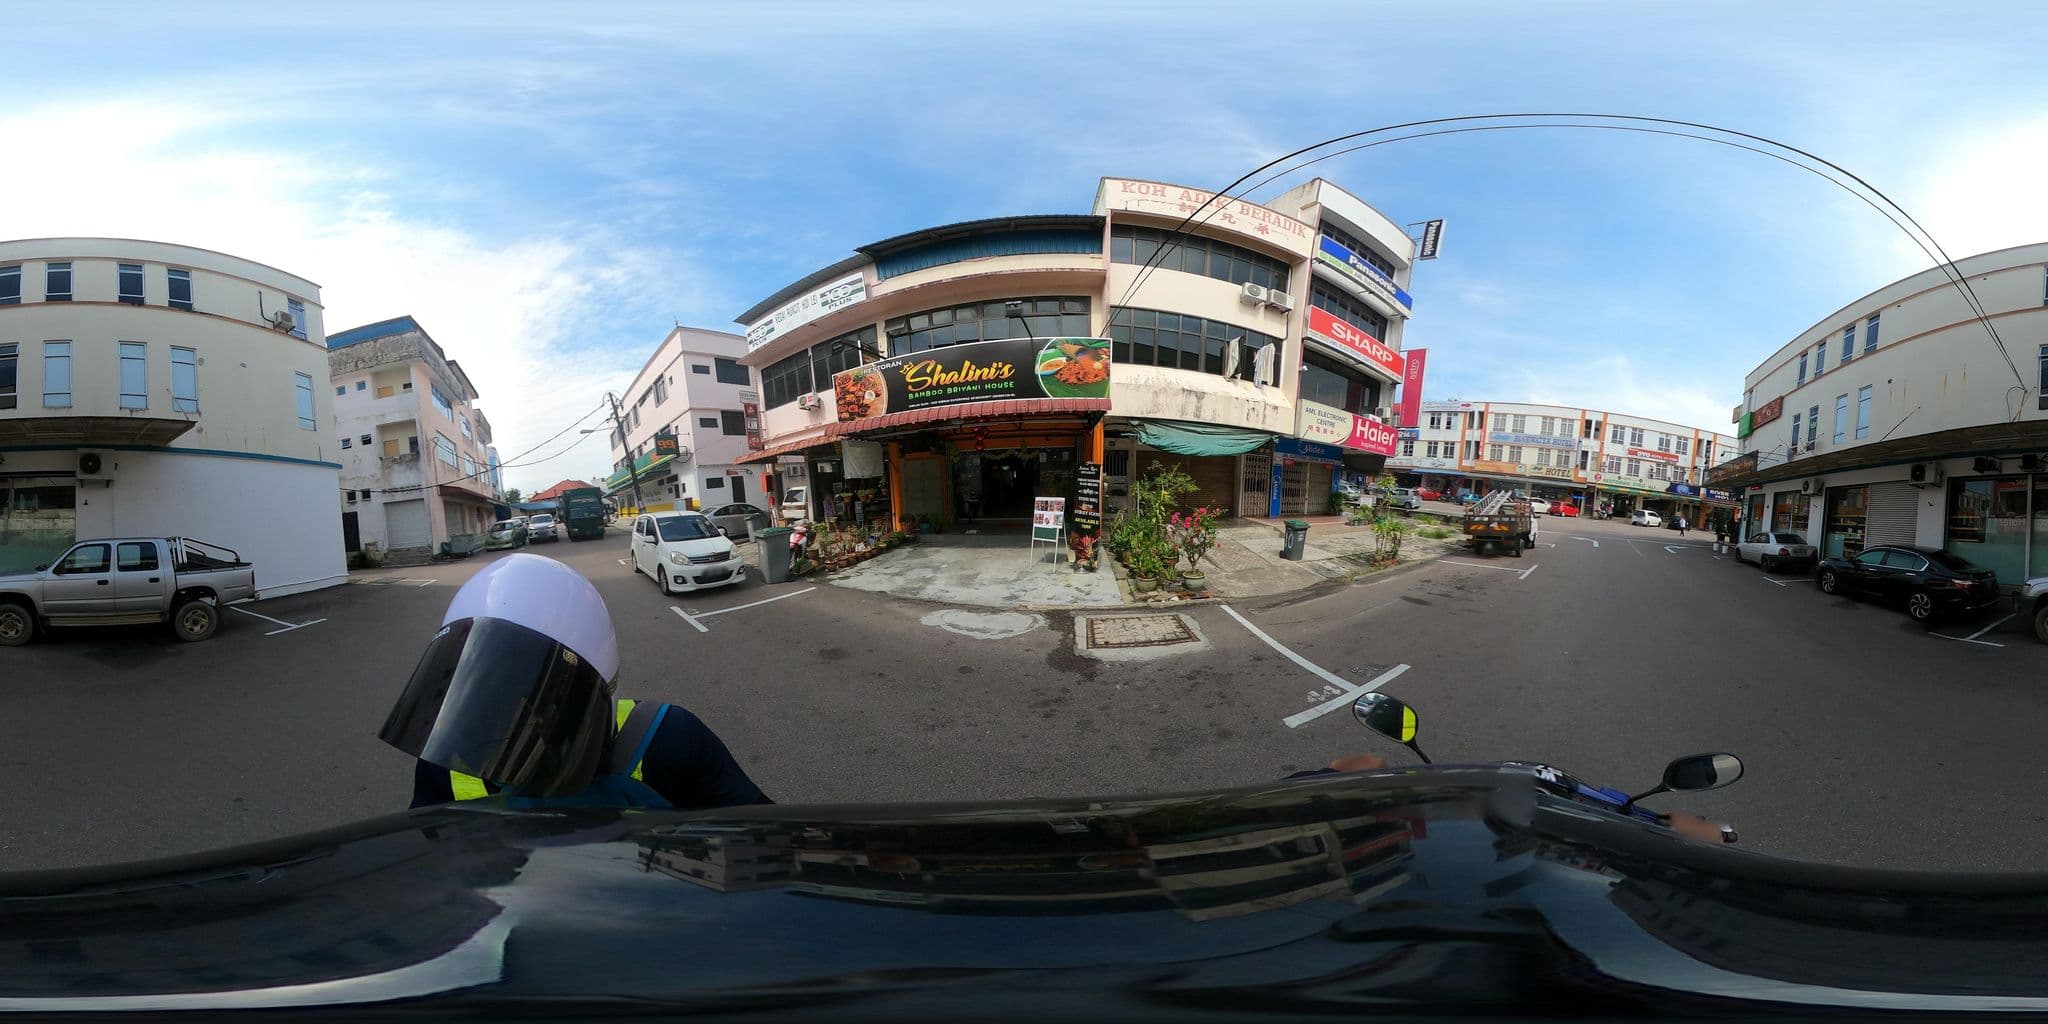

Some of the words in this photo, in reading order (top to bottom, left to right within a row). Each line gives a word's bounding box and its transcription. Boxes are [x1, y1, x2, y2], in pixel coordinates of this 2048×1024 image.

[1121, 180, 1167, 198] KOH
[1179, 189, 1229, 211] ADIK
[1239, 202, 1308, 239] BERADIK
[1349, 254, 1397, 295] Panasonic
[829, 297, 853, 310] PLUS
[1331, 322, 1393, 362] SHARP
[863, 360, 902, 375] RESTORAN
[905, 359, 1016, 392] Shalini's
[908, 389, 943, 400] BAMBOO
[947, 385, 981, 394] BRIYANI
[985, 381, 1015, 390] HOUSE
[1356, 419, 1394, 446] Haier
[657, 440, 676, 450] 99
[1545, 468, 1572, 478] HOTEL
